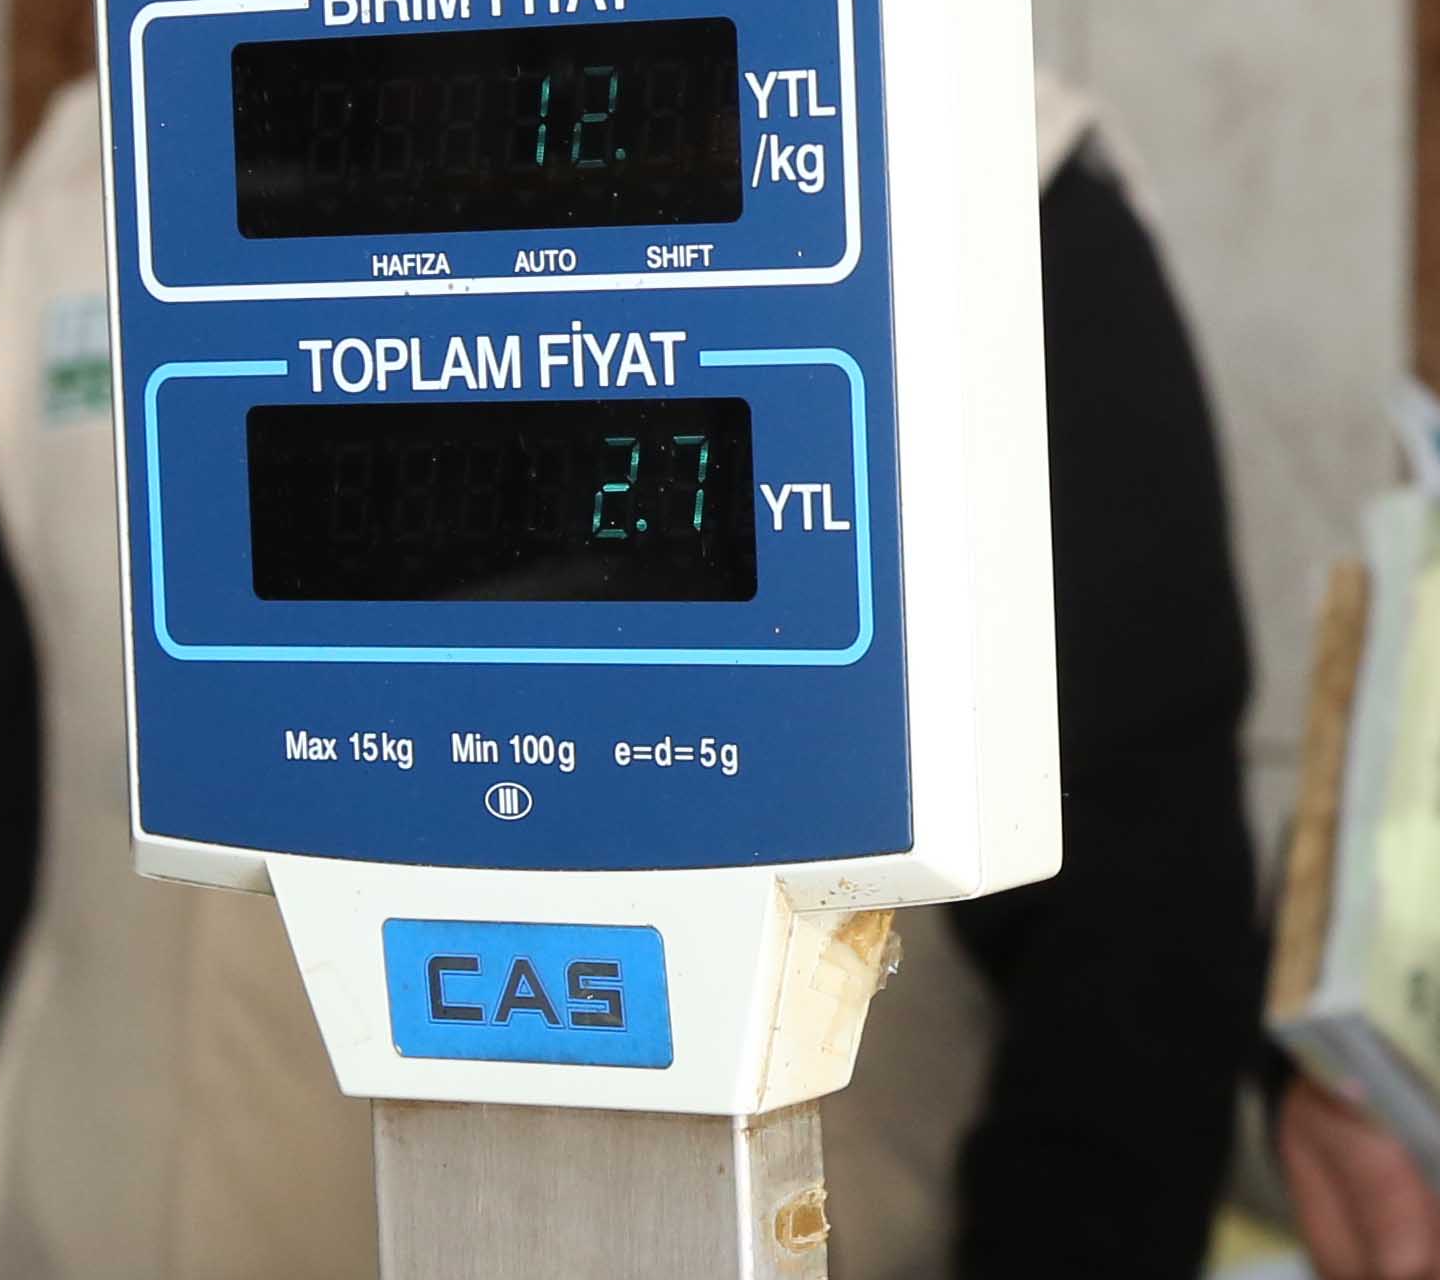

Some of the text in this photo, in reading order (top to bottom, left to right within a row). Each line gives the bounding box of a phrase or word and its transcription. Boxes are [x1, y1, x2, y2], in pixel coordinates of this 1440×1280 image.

[745, 70, 836, 119] YTL
[751, 134, 826, 195] /kg
[371, 243, 713, 277] HAFIZA AUTO SHIFT
[298, 320, 687, 394] TOPLAM FİYAT
[592, 435, 710, 539] 2.7
[759, 483, 851, 532] YTL
[285, 730, 337, 762] Max
[451, 732, 499, 764] Min
[425, 955, 625, 1031] CAS
